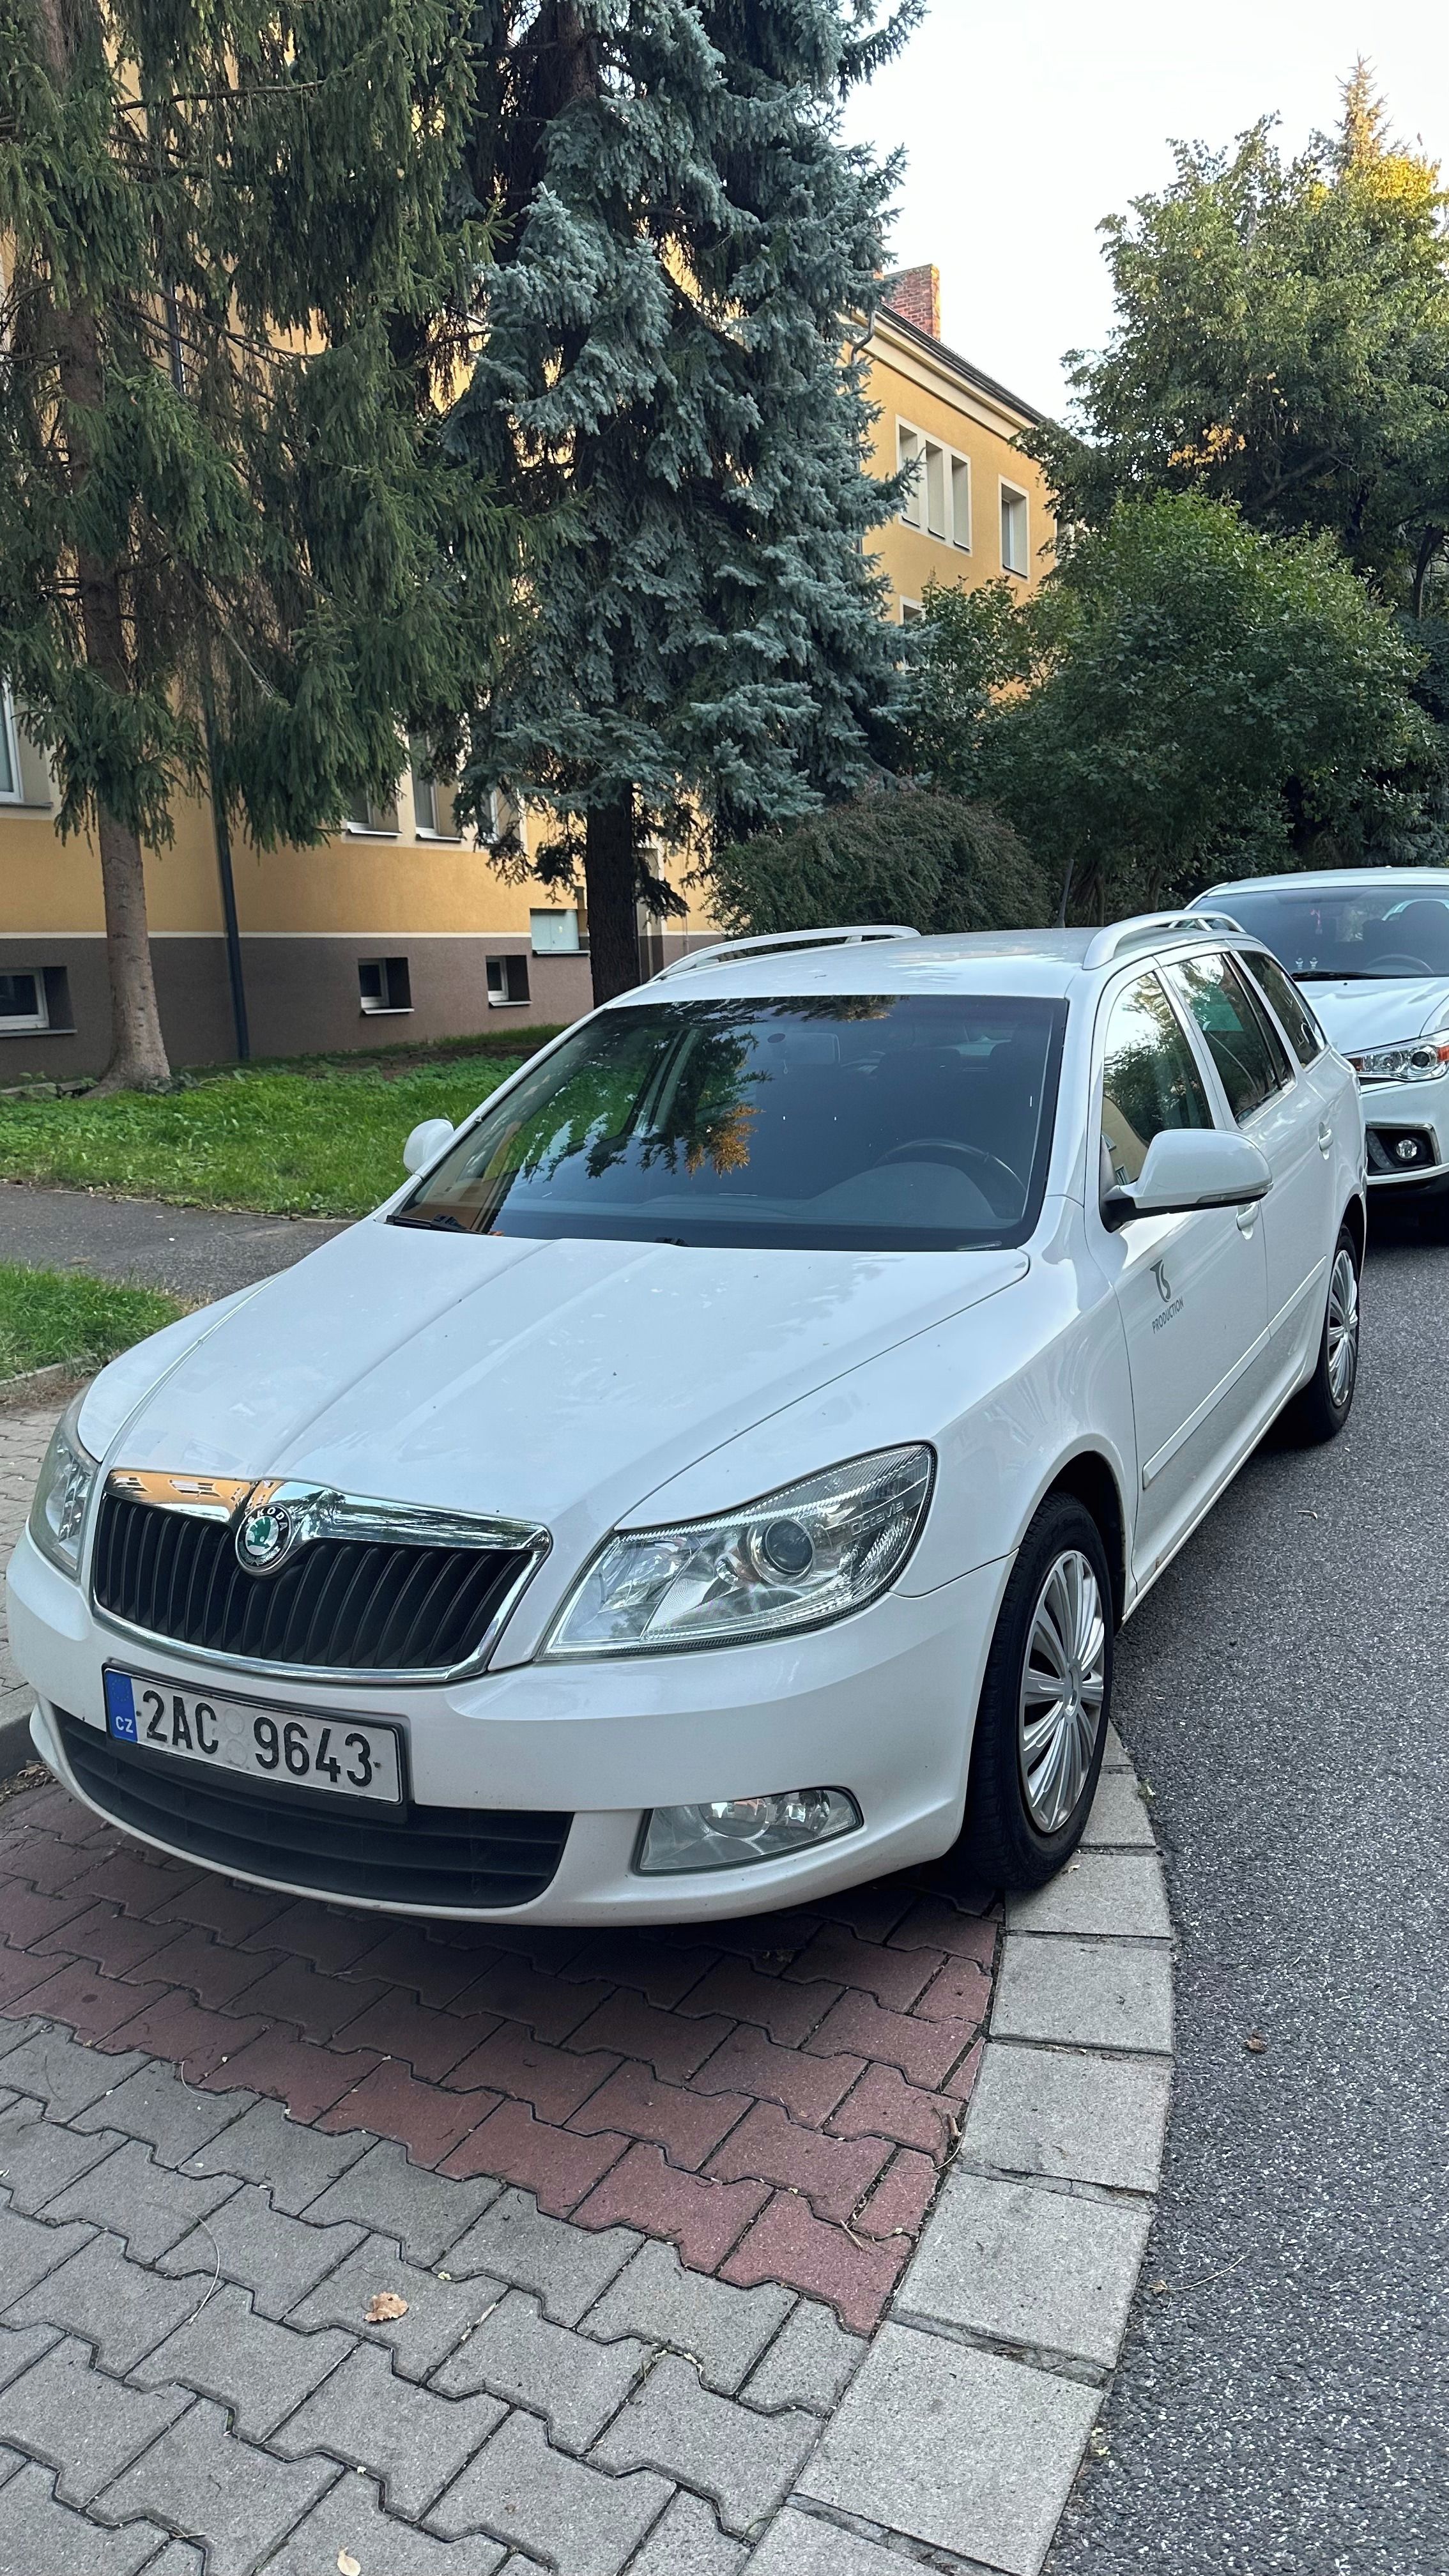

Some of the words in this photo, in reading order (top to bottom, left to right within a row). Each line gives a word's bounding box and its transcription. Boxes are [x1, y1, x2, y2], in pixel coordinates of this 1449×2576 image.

[1152, 1296, 1184, 1334] PRODUCTION
[852, 1501, 904, 1535] Octavia
[116, 1716, 134, 1733] CZ
[142, 1690, 218, 1754] 2AC
[254, 1717, 372, 1787] 9643
